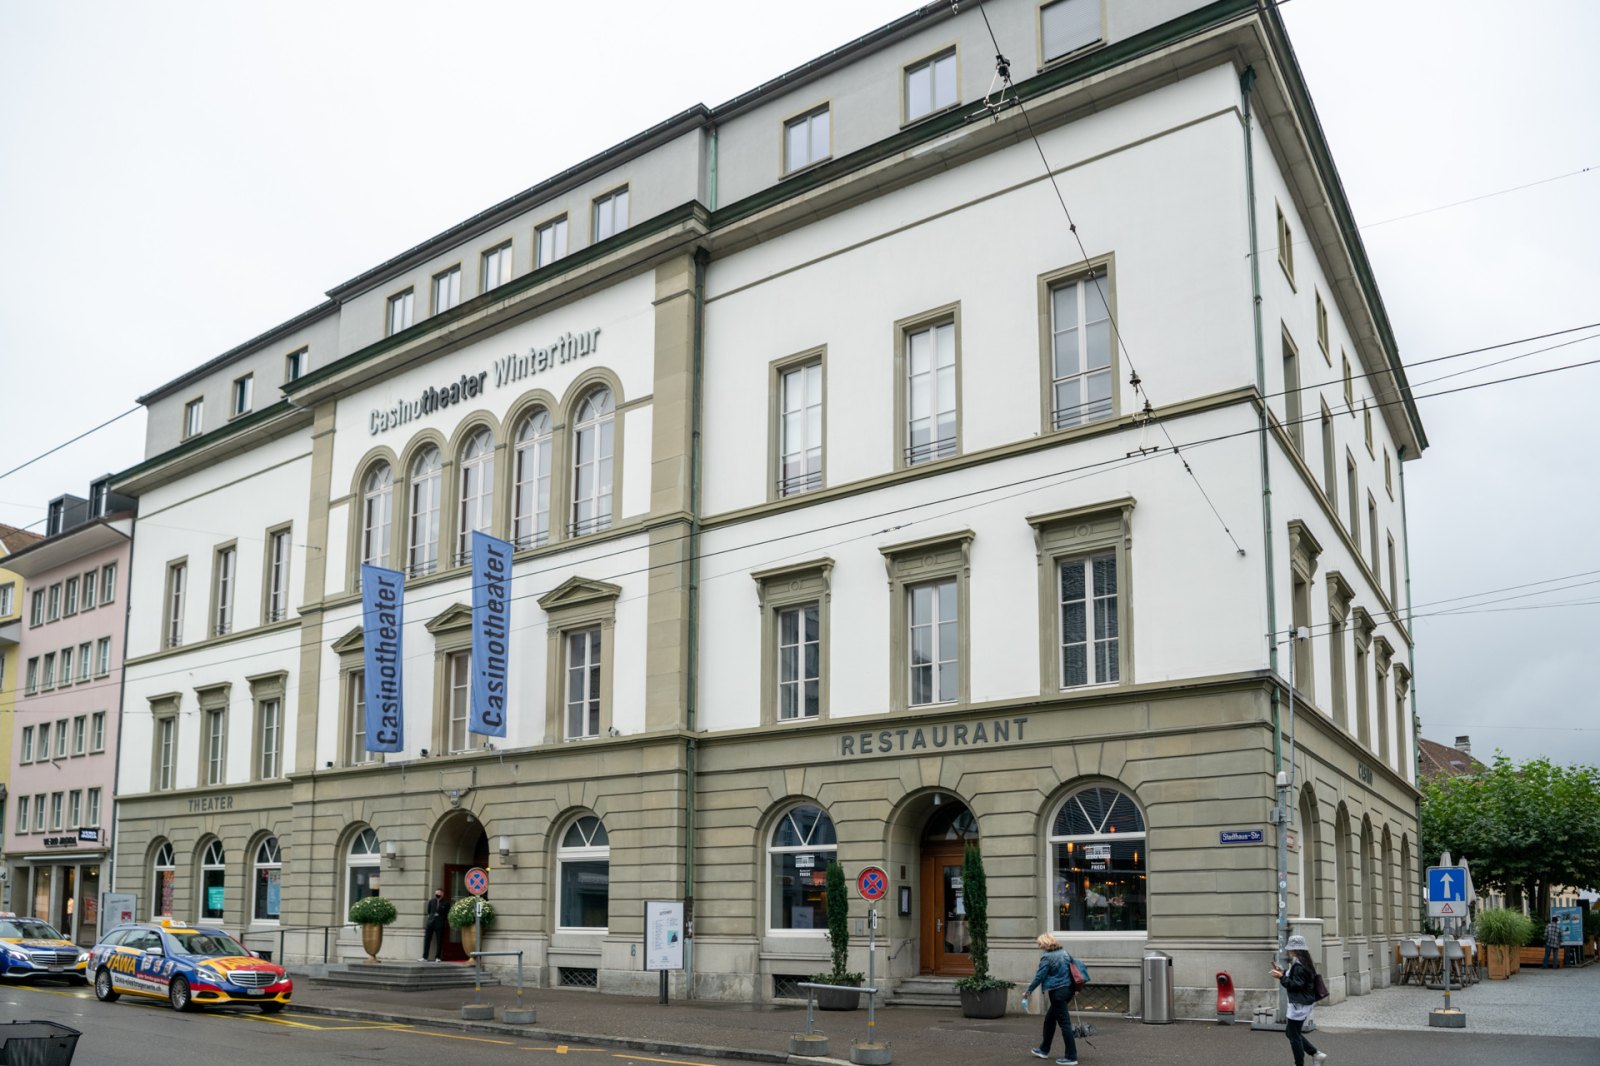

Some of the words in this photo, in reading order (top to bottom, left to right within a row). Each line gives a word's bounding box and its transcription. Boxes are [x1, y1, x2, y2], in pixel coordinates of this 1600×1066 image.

[368, 370, 487, 436] Casinotheater
[492, 327, 601, 388] Winterthur
[374, 576, 398, 745] Casinotheater
[481, 544, 505, 728] Casinotheater
[841, 717, 1028, 756] RESTAURANT
[188, 795, 234, 813] THEATER
[1222, 831, 1261, 841] Stadthaus-Str.
